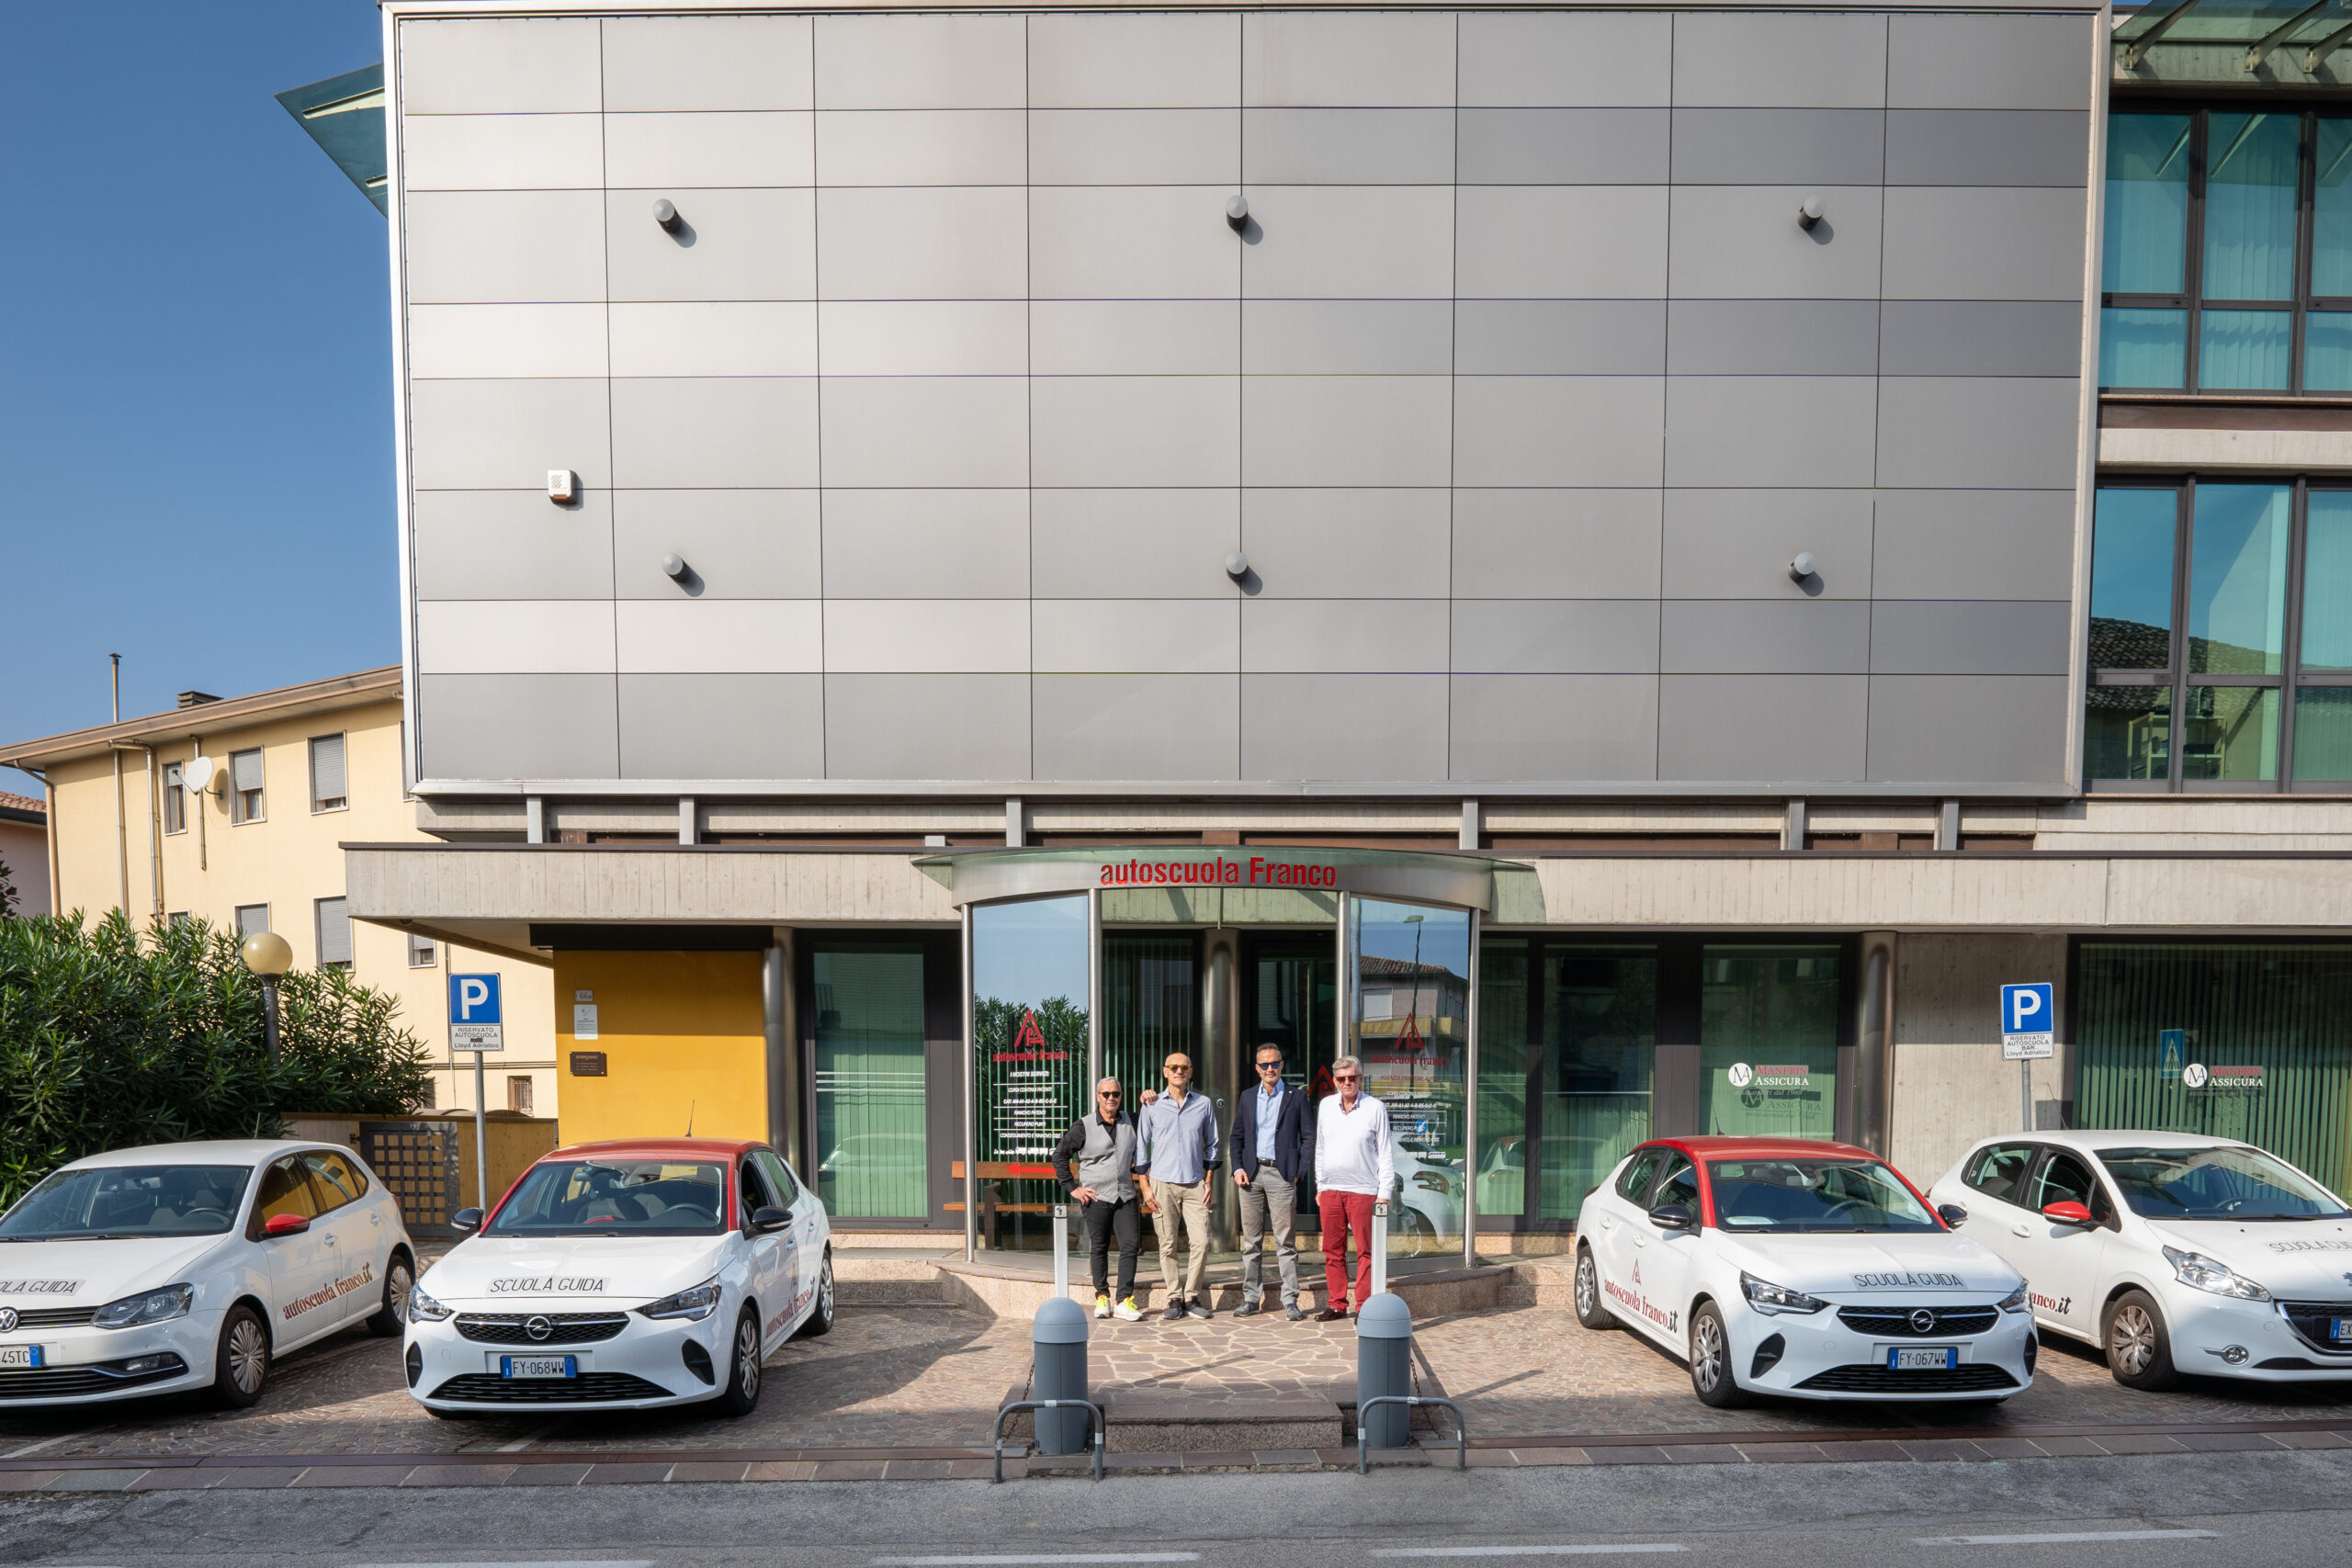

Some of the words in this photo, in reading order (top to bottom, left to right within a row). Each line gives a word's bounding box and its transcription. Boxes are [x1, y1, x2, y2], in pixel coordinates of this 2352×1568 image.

[1101, 856, 1239, 886] autoscuola
[1250, 856, 1337, 887] Franco
[460, 978, 489, 1020] P
[2013, 989, 2041, 1030] P
[992, 1049, 1037, 1062] autoscuola
[1039, 1048, 1069, 1061] franco
[1370, 1053, 1418, 1065] autoscuola
[1419, 1054, 1448, 1066] franco
[1756, 1065, 1807, 1076] MANFRIN
[2211, 1066, 2263, 1076] MANFRIN
[1755, 1077, 1809, 1086] ASSICURA
[2209, 1077, 2264, 1087] ASSICURA
[2269, 1241, 2330, 1252] SCUOLA
[28, 1280, 77, 1293] GUIDA
[490, 1277, 553, 1293] SCUOLA
[558, 1278, 604, 1292] GUIDA
[1854, 1272, 1917, 1287] SCUOLA
[1917, 1272, 1964, 1287] GUIDA
[283, 1283, 337, 1320] autoscuola
[334, 1261, 373, 1296] franco.it
[1604, 1279, 1641, 1312] autoscuola
[1642, 1295, 1679, 1334] franco.it
